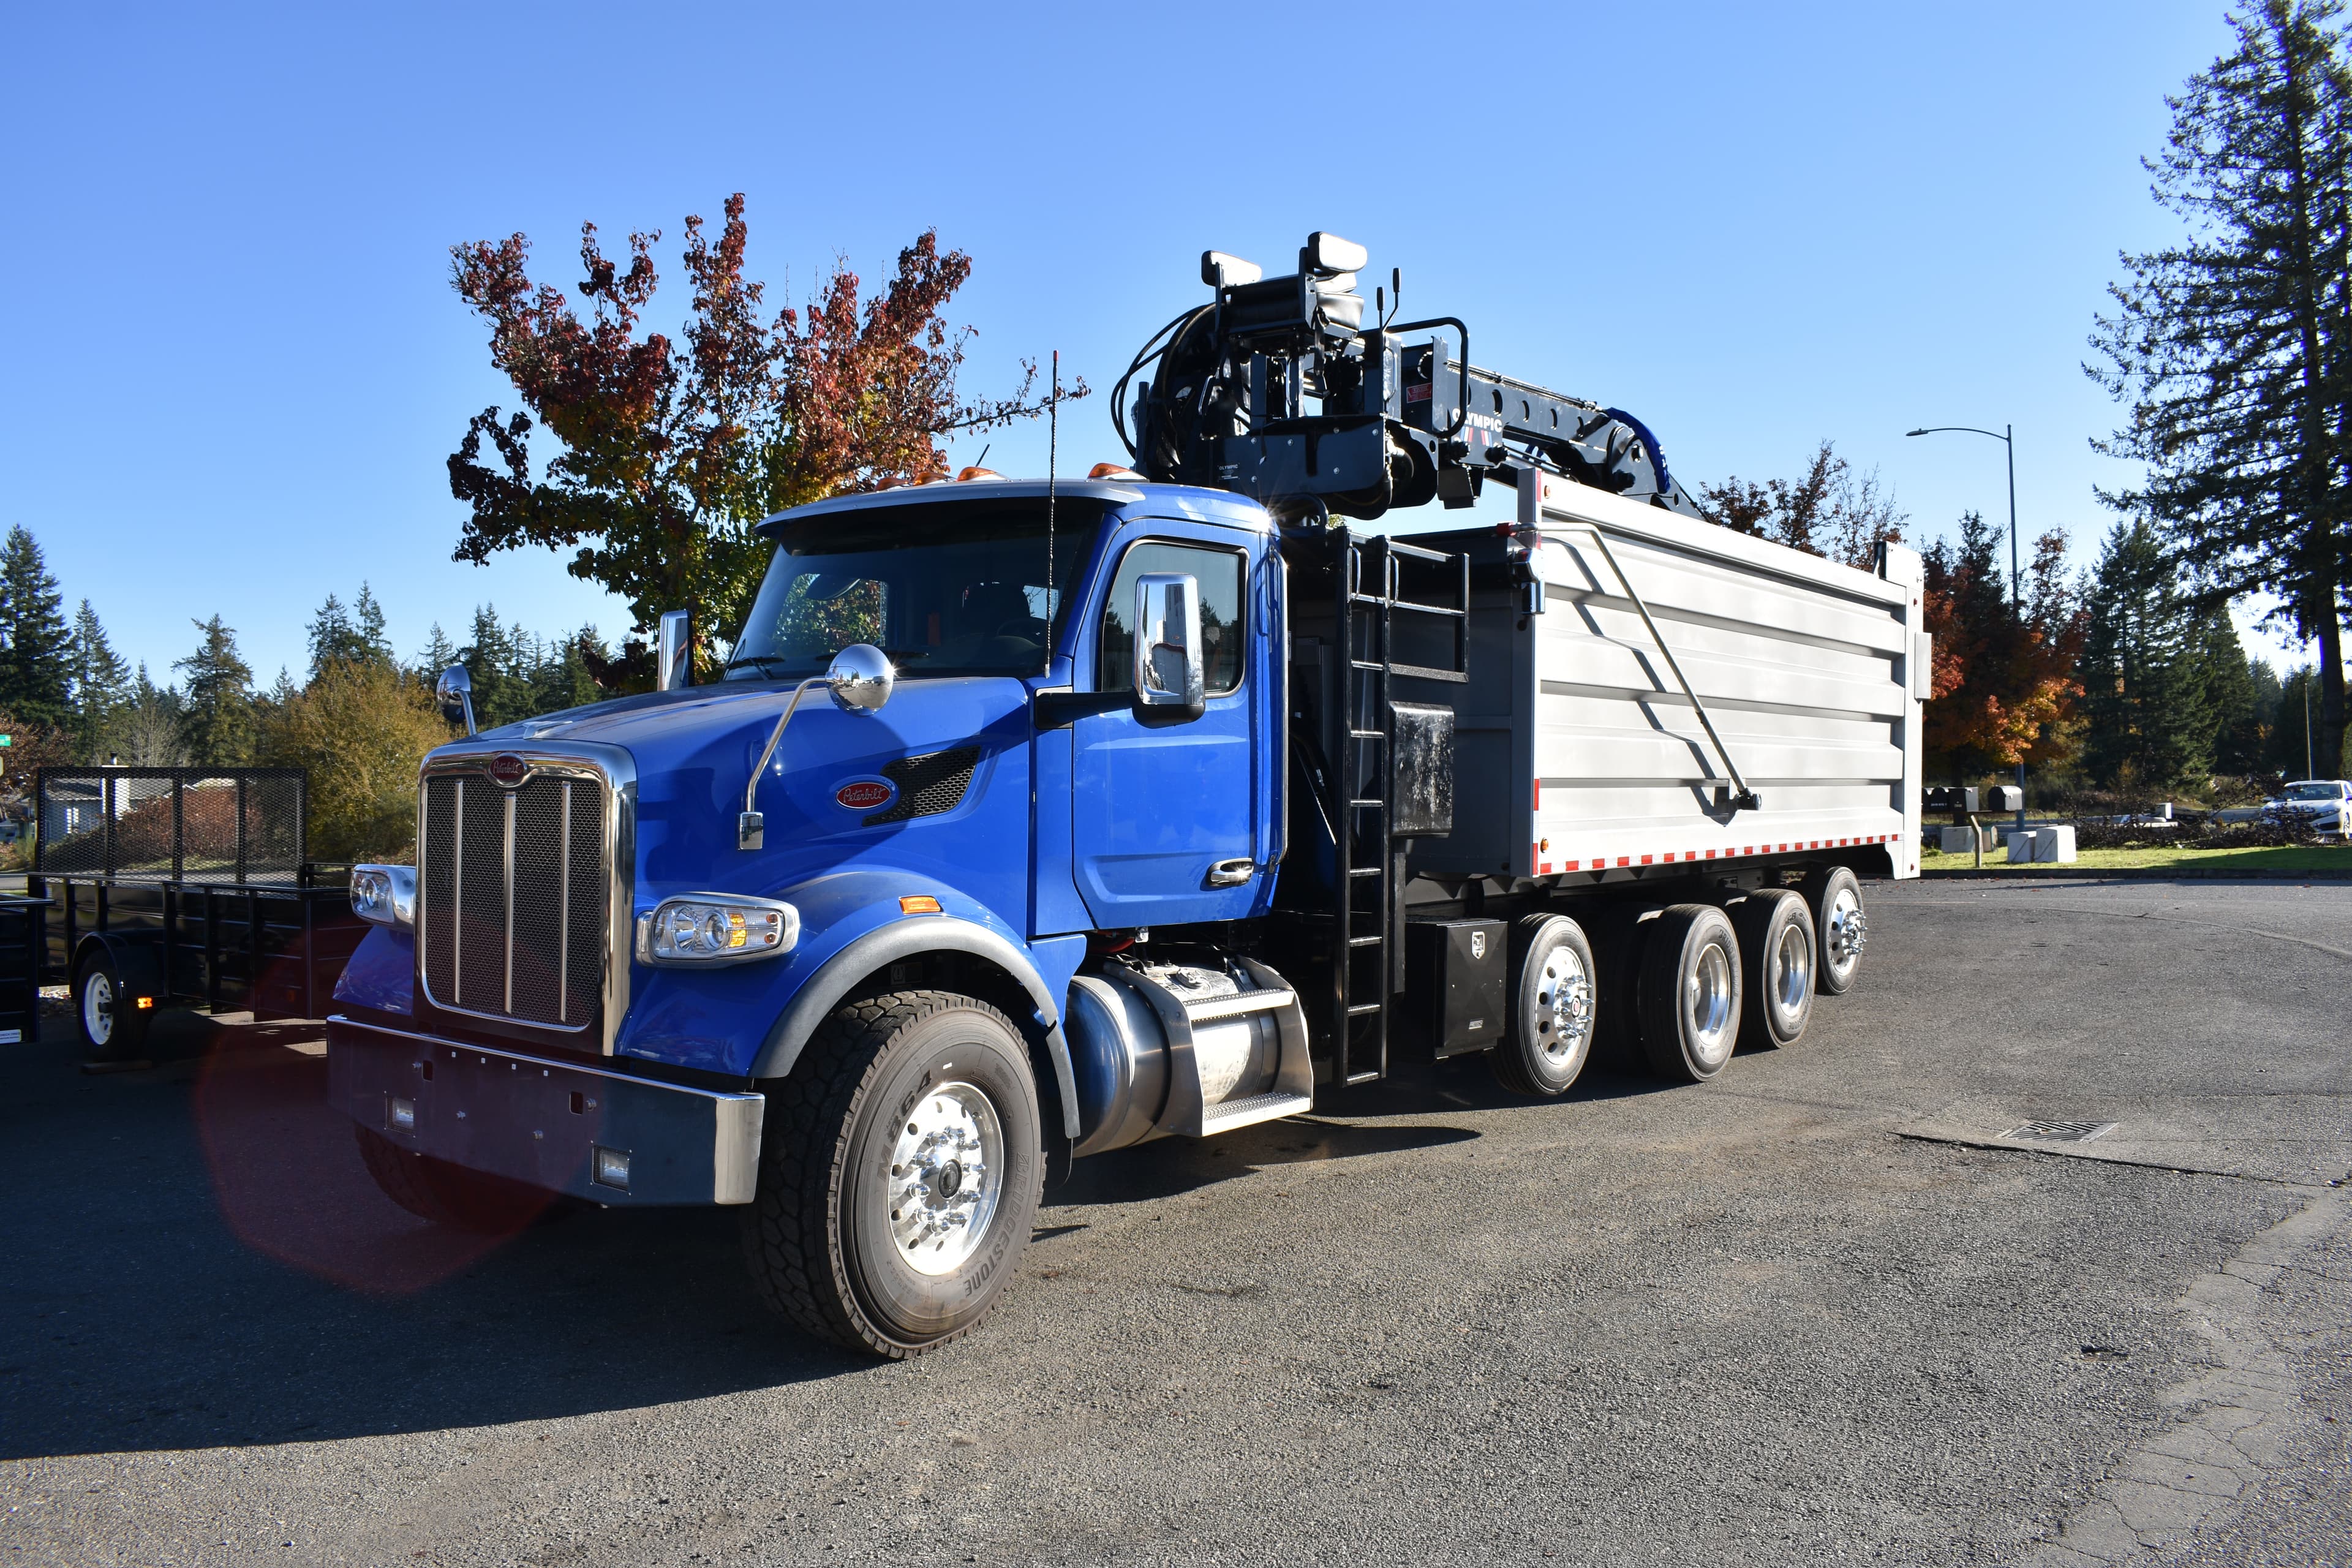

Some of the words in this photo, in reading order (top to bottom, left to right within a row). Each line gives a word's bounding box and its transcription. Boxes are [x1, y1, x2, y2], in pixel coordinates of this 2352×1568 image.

[493, 760, 522, 774] Peterbilt
[843, 788, 886, 804] Peterbilt
[877, 1069, 932, 1182] M864
[964, 1152, 1030, 1298] BRIDGESTONE
